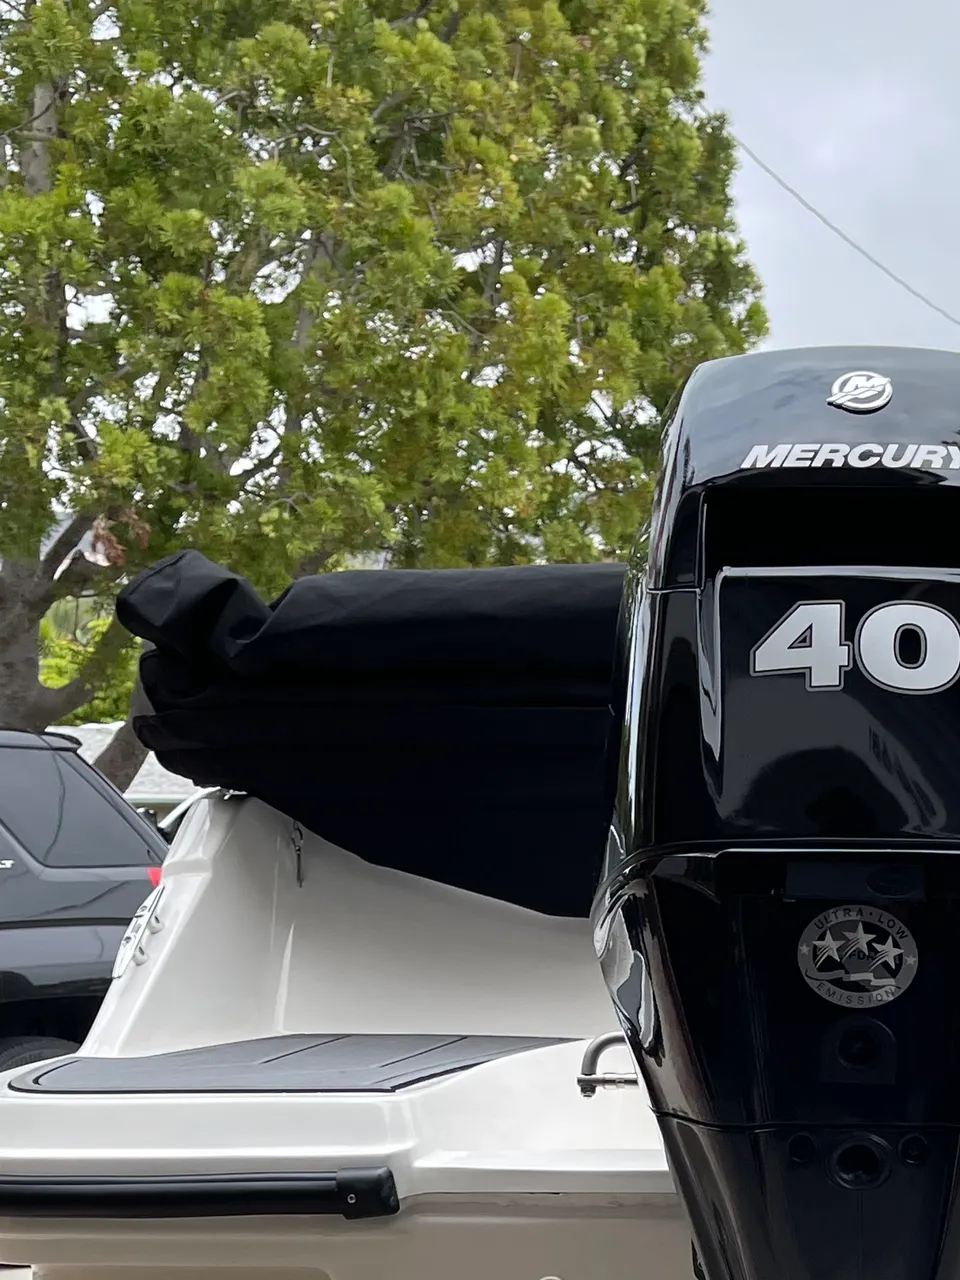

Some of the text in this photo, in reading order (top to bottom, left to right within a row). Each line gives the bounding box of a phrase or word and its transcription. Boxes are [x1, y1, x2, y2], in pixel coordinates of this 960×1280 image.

[813, 907, 909, 941] ULTRA LOW
[815, 981, 898, 1006] EMISSION
